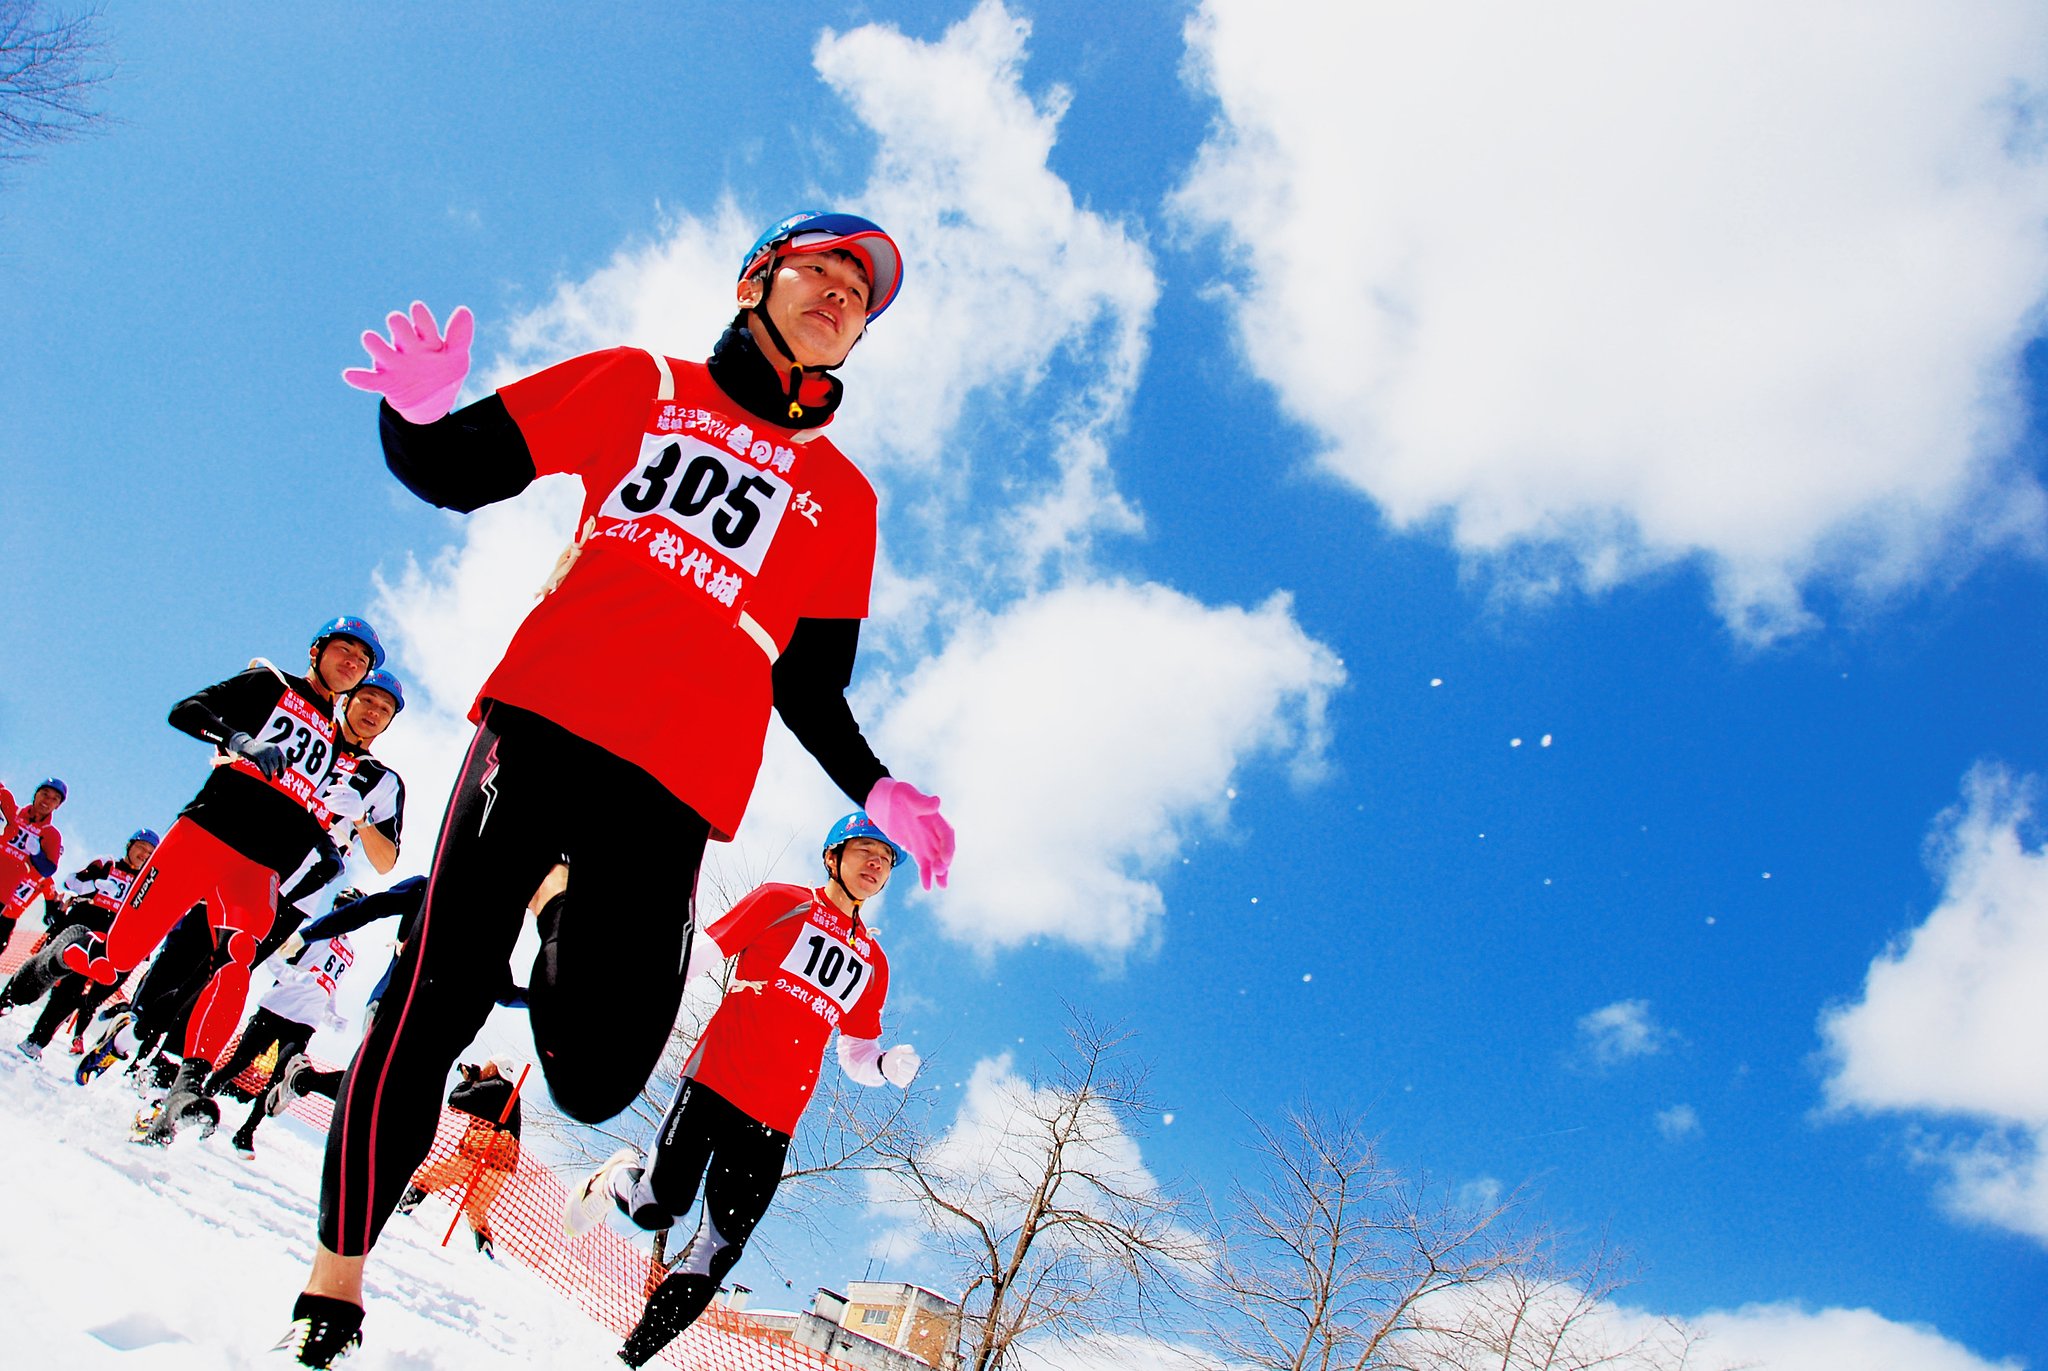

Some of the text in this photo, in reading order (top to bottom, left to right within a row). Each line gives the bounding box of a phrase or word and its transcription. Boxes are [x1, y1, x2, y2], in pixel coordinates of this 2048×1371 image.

[620, 442, 776, 549] 305
[791, 490, 822, 527] 紅
[264, 715, 328, 776] 238
[132, 867, 157, 908] phenix
[803, 935, 863, 1001] 107
